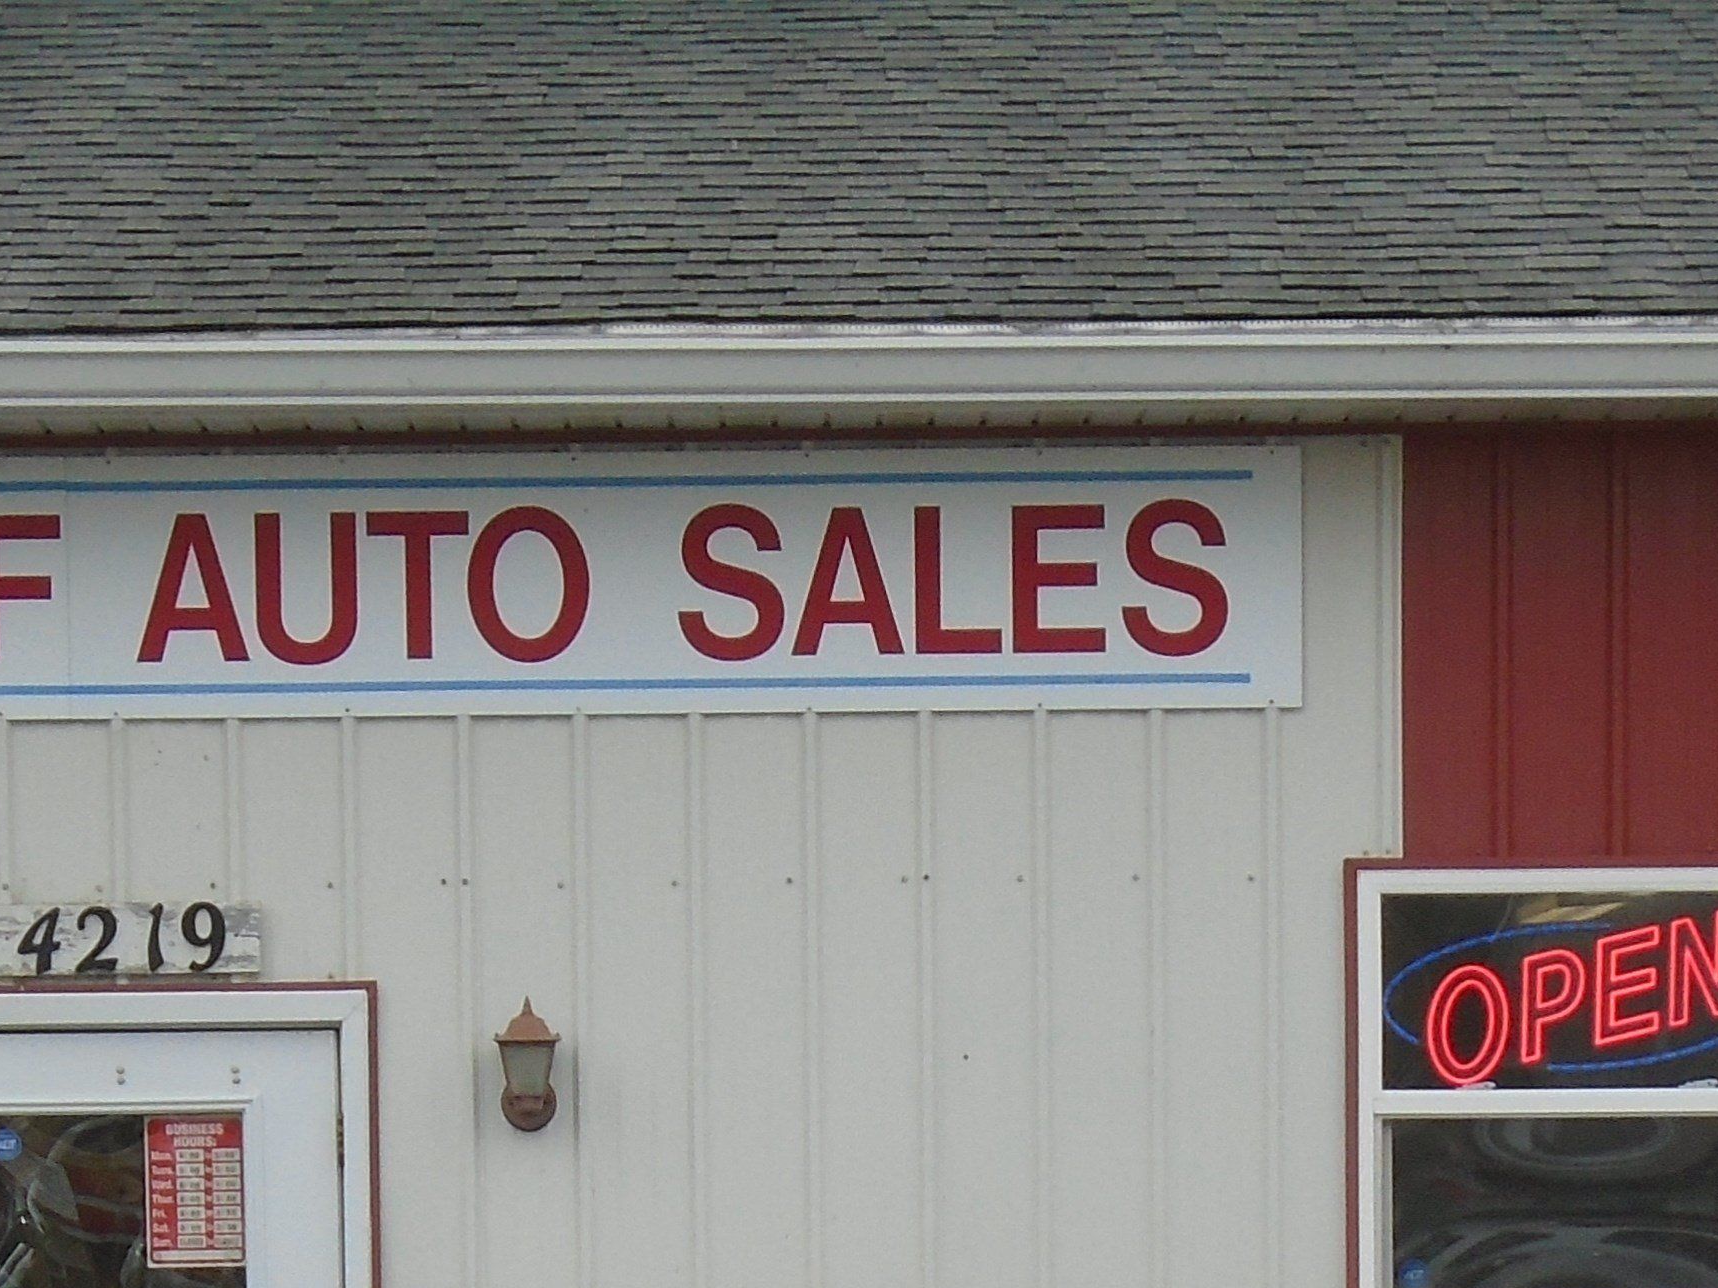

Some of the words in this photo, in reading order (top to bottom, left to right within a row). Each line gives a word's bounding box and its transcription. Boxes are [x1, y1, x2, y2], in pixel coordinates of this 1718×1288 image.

[136, 505, 592, 665] AUTO
[676, 498, 1229, 661] SALES
[17, 901, 226, 975] 4219
